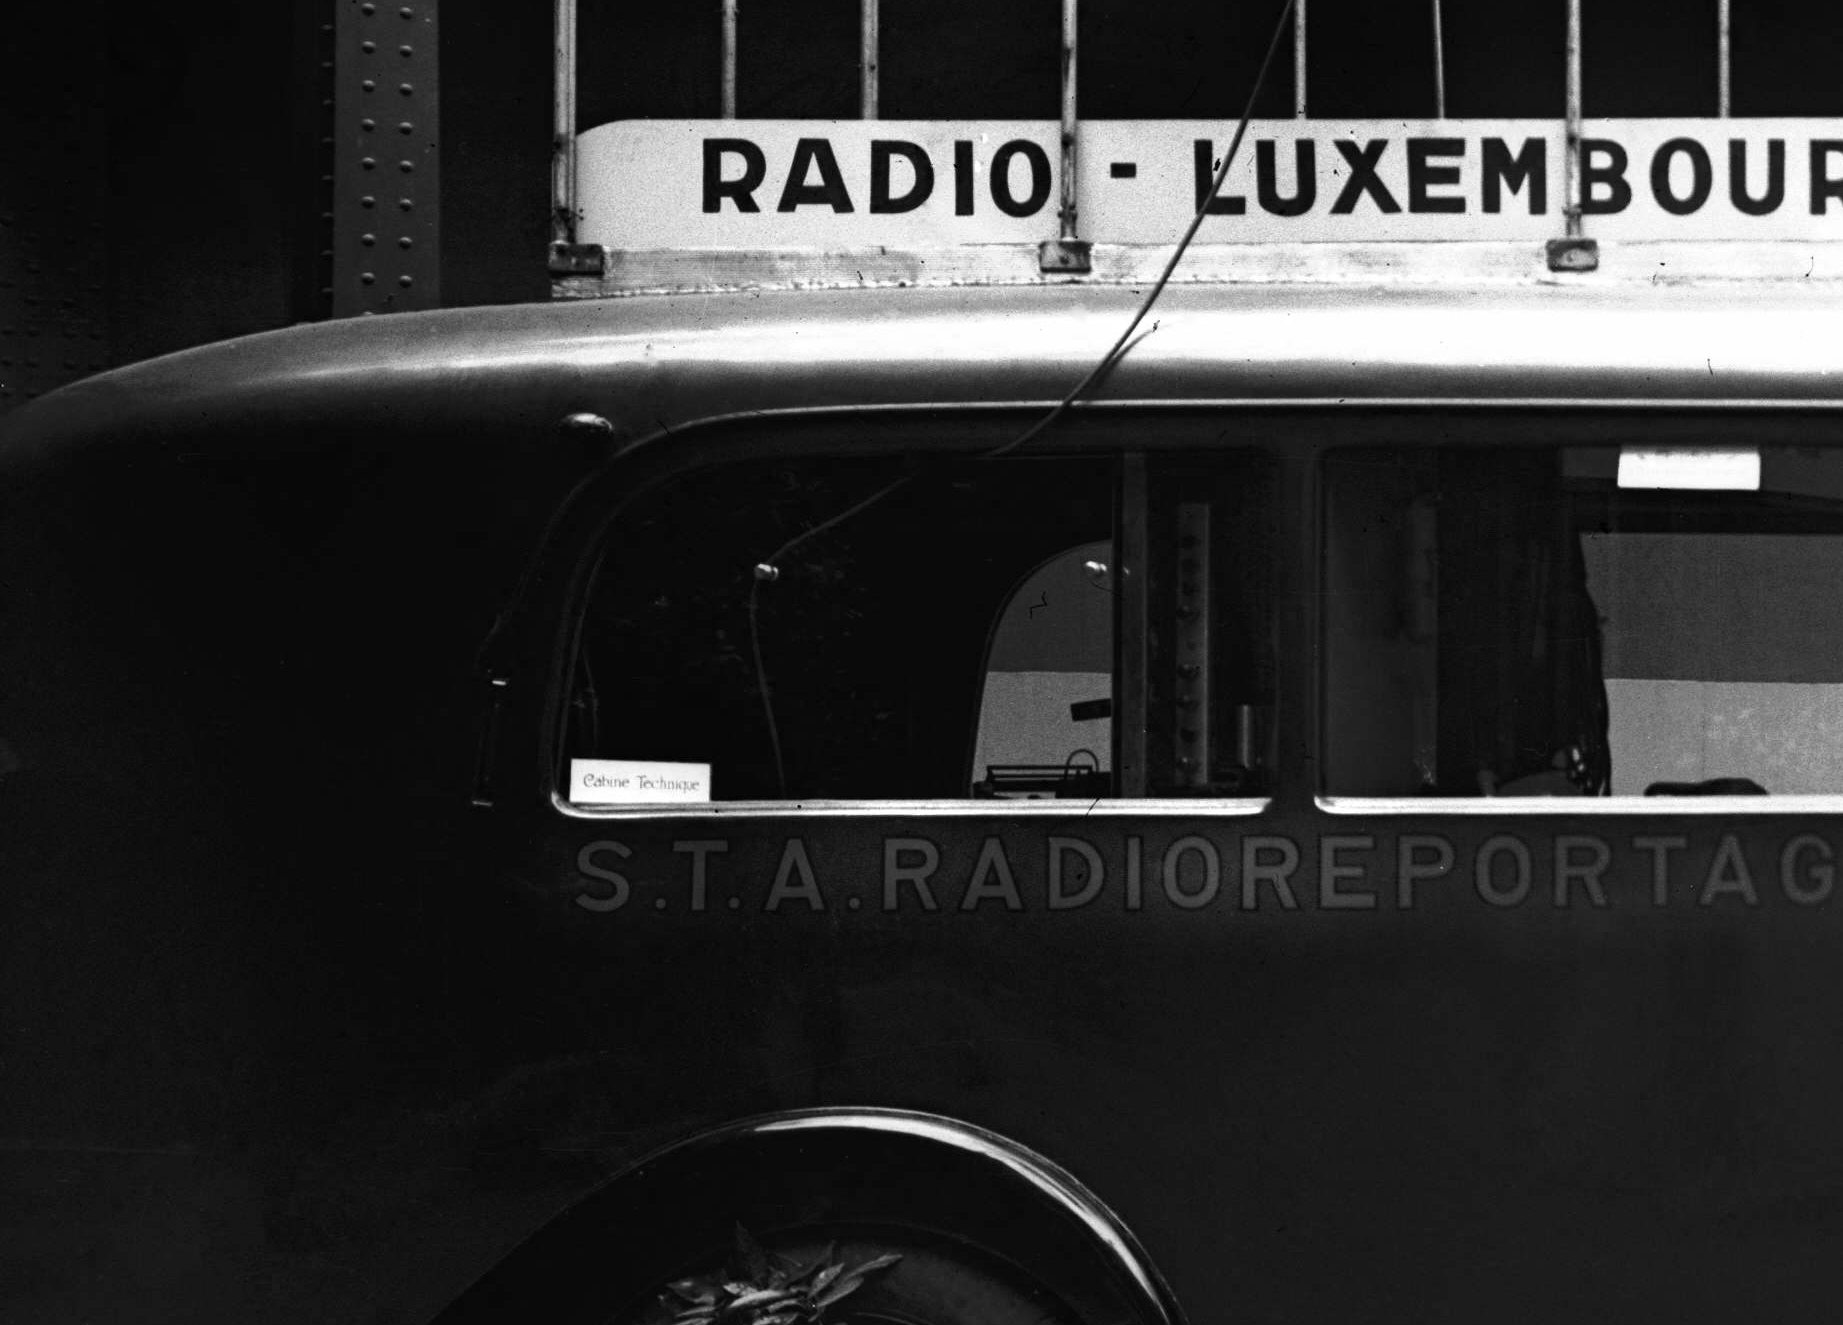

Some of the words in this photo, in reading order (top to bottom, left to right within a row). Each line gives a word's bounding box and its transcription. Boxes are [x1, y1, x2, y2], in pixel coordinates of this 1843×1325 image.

[702, 137, 1053, 218] RADIO
[582, 773, 631, 789] Cabine
[636, 773, 700, 794] Technique
